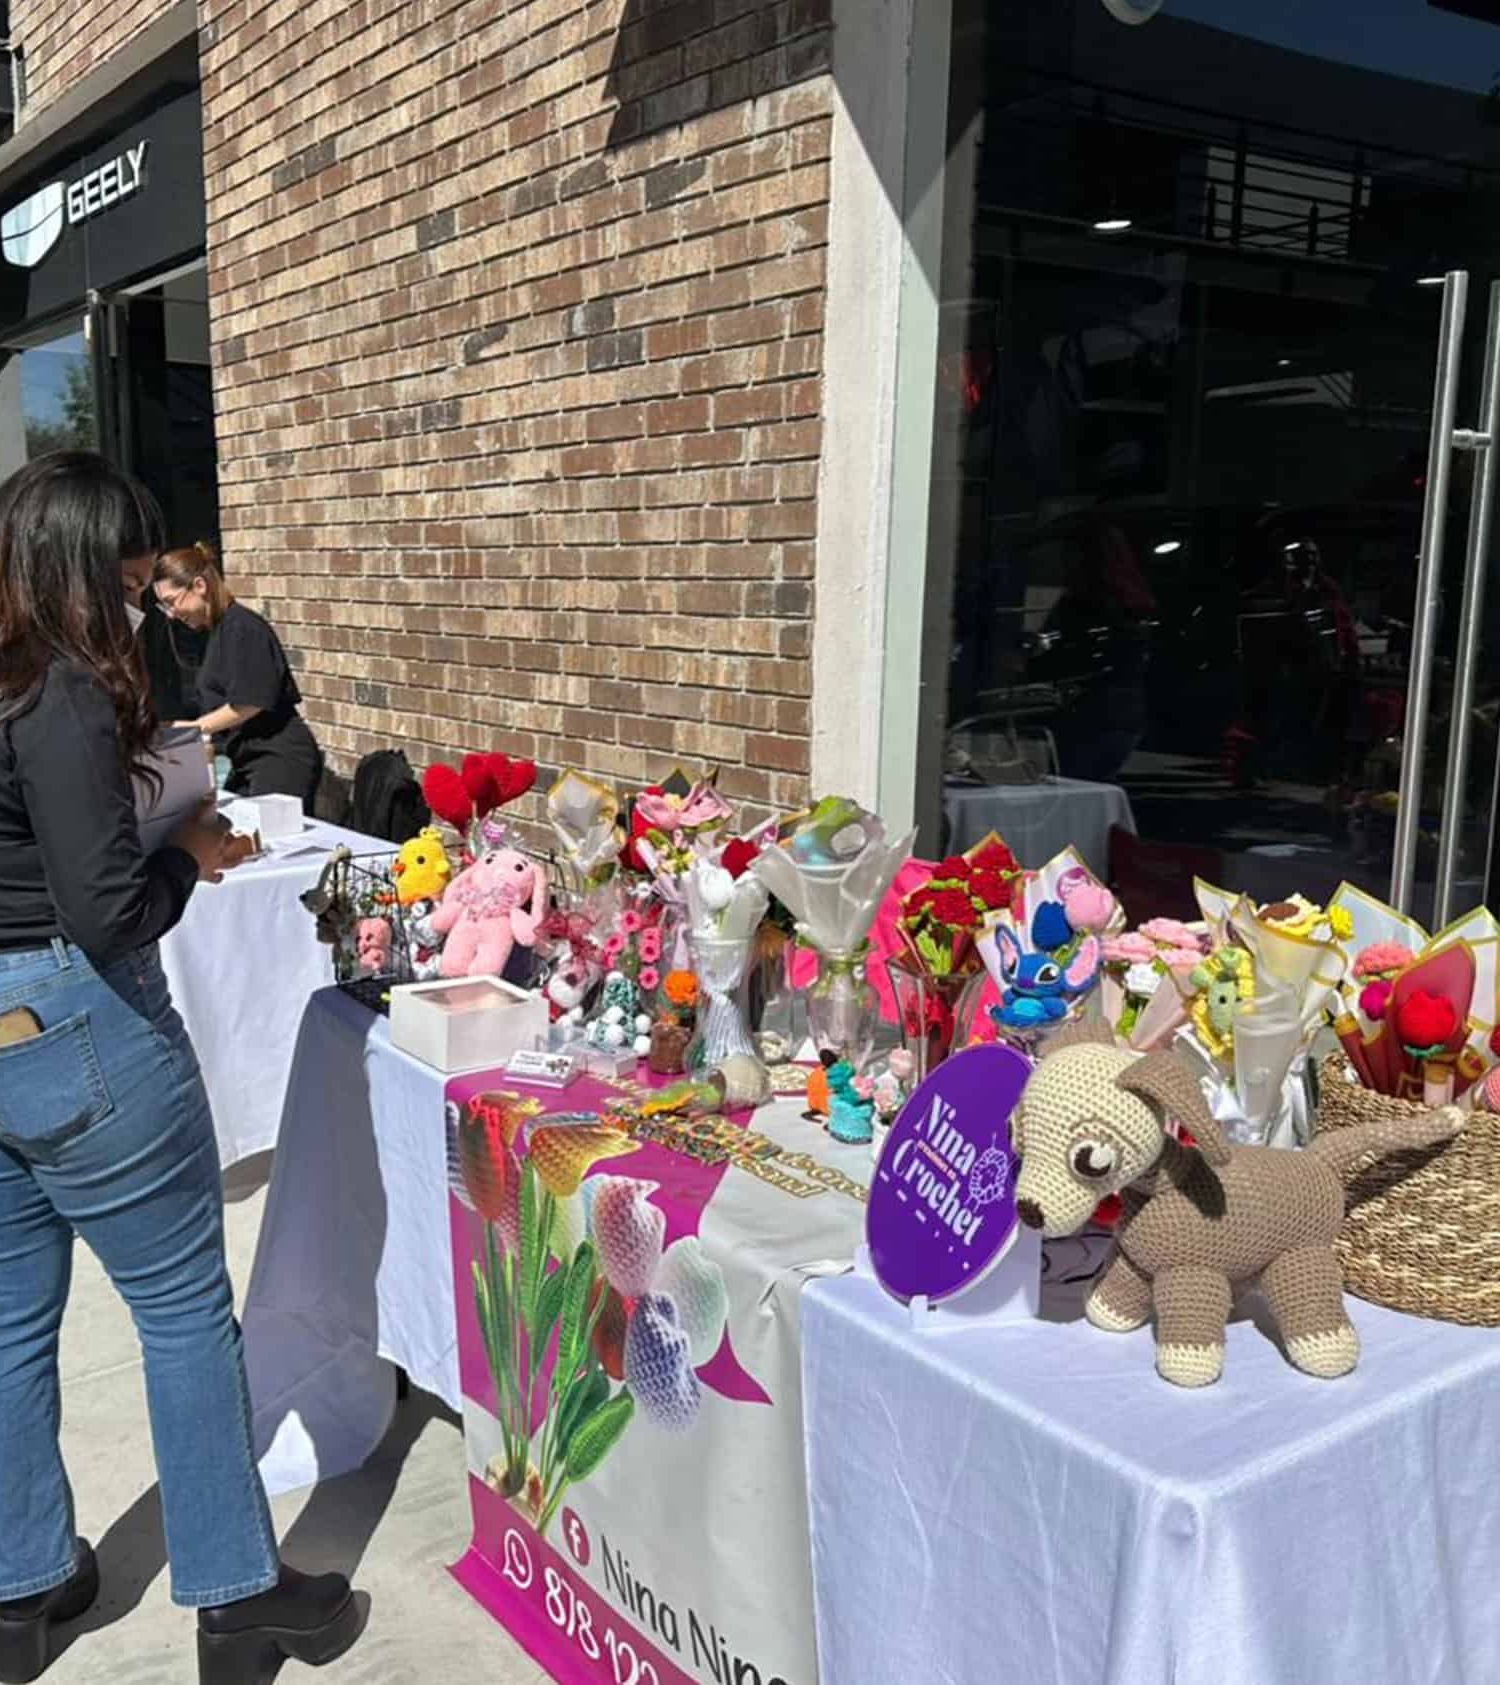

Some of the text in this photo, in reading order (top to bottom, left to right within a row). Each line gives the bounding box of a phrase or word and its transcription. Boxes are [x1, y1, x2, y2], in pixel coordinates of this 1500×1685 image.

[67, 140, 150, 224] GEELY
[914, 1094, 977, 1176] Nina
[892, 1138, 985, 1246] Crochet
[544, 1566, 599, 1660] 878
[601, 1534, 680, 1652] Nina
[688, 1607, 790, 1685] Nin
